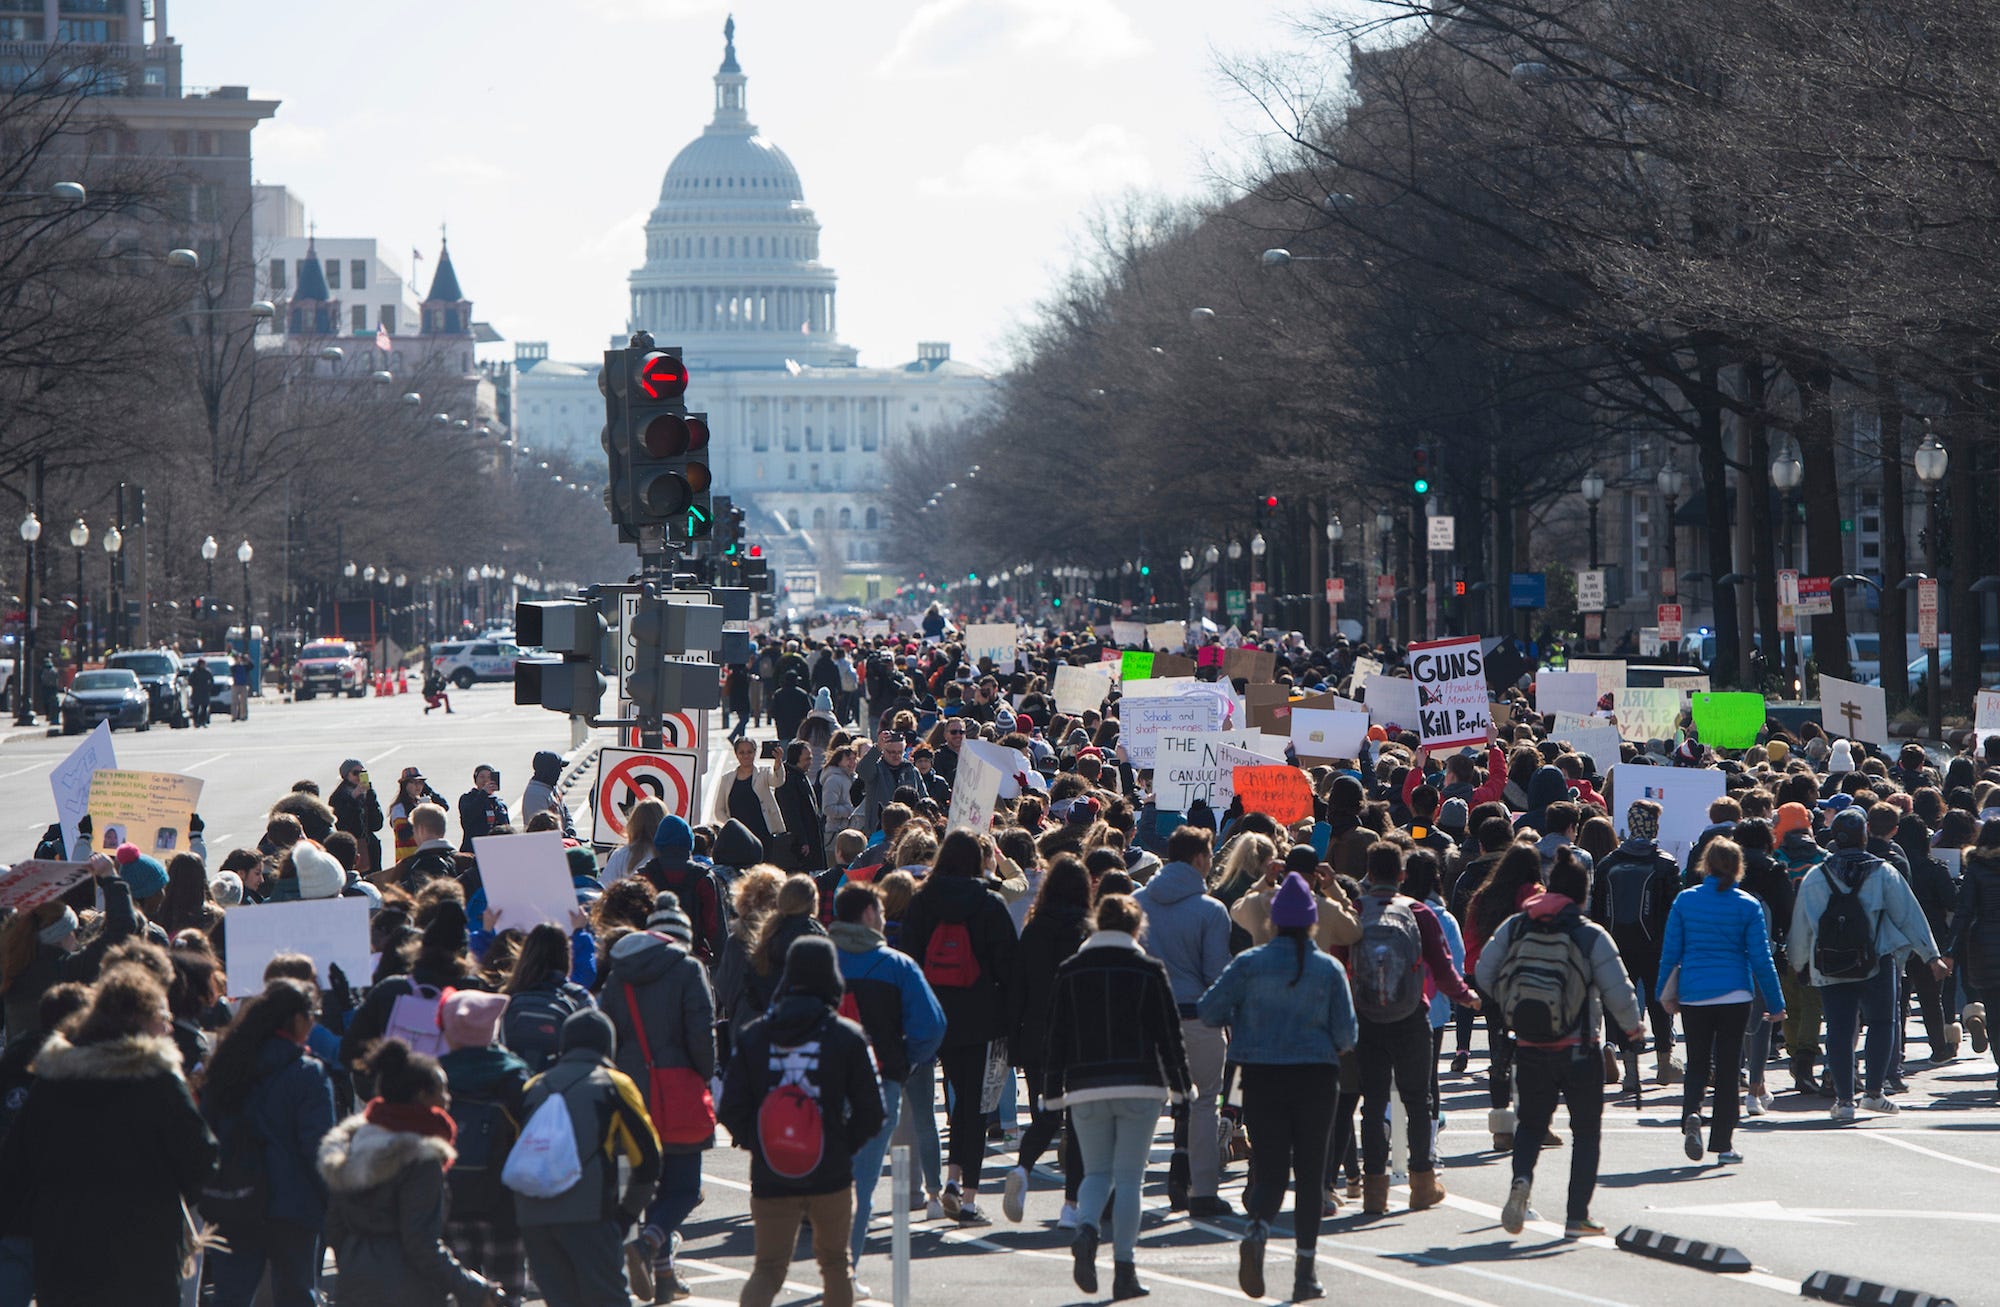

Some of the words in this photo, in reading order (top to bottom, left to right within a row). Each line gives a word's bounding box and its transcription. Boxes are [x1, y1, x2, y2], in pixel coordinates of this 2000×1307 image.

[1590, 591, 1602, 599] RED
[967, 645, 1014, 662] LIVES
[1413, 649, 1481, 683] GUNS
[1143, 709, 1172, 722] Schools
[1178, 709, 1194, 721] and
[1419, 709, 1452, 738] Kill
[1456, 709, 1488, 734] People
[1164, 737, 1196, 752] THE
[1168, 768, 1194, 783] CAN
